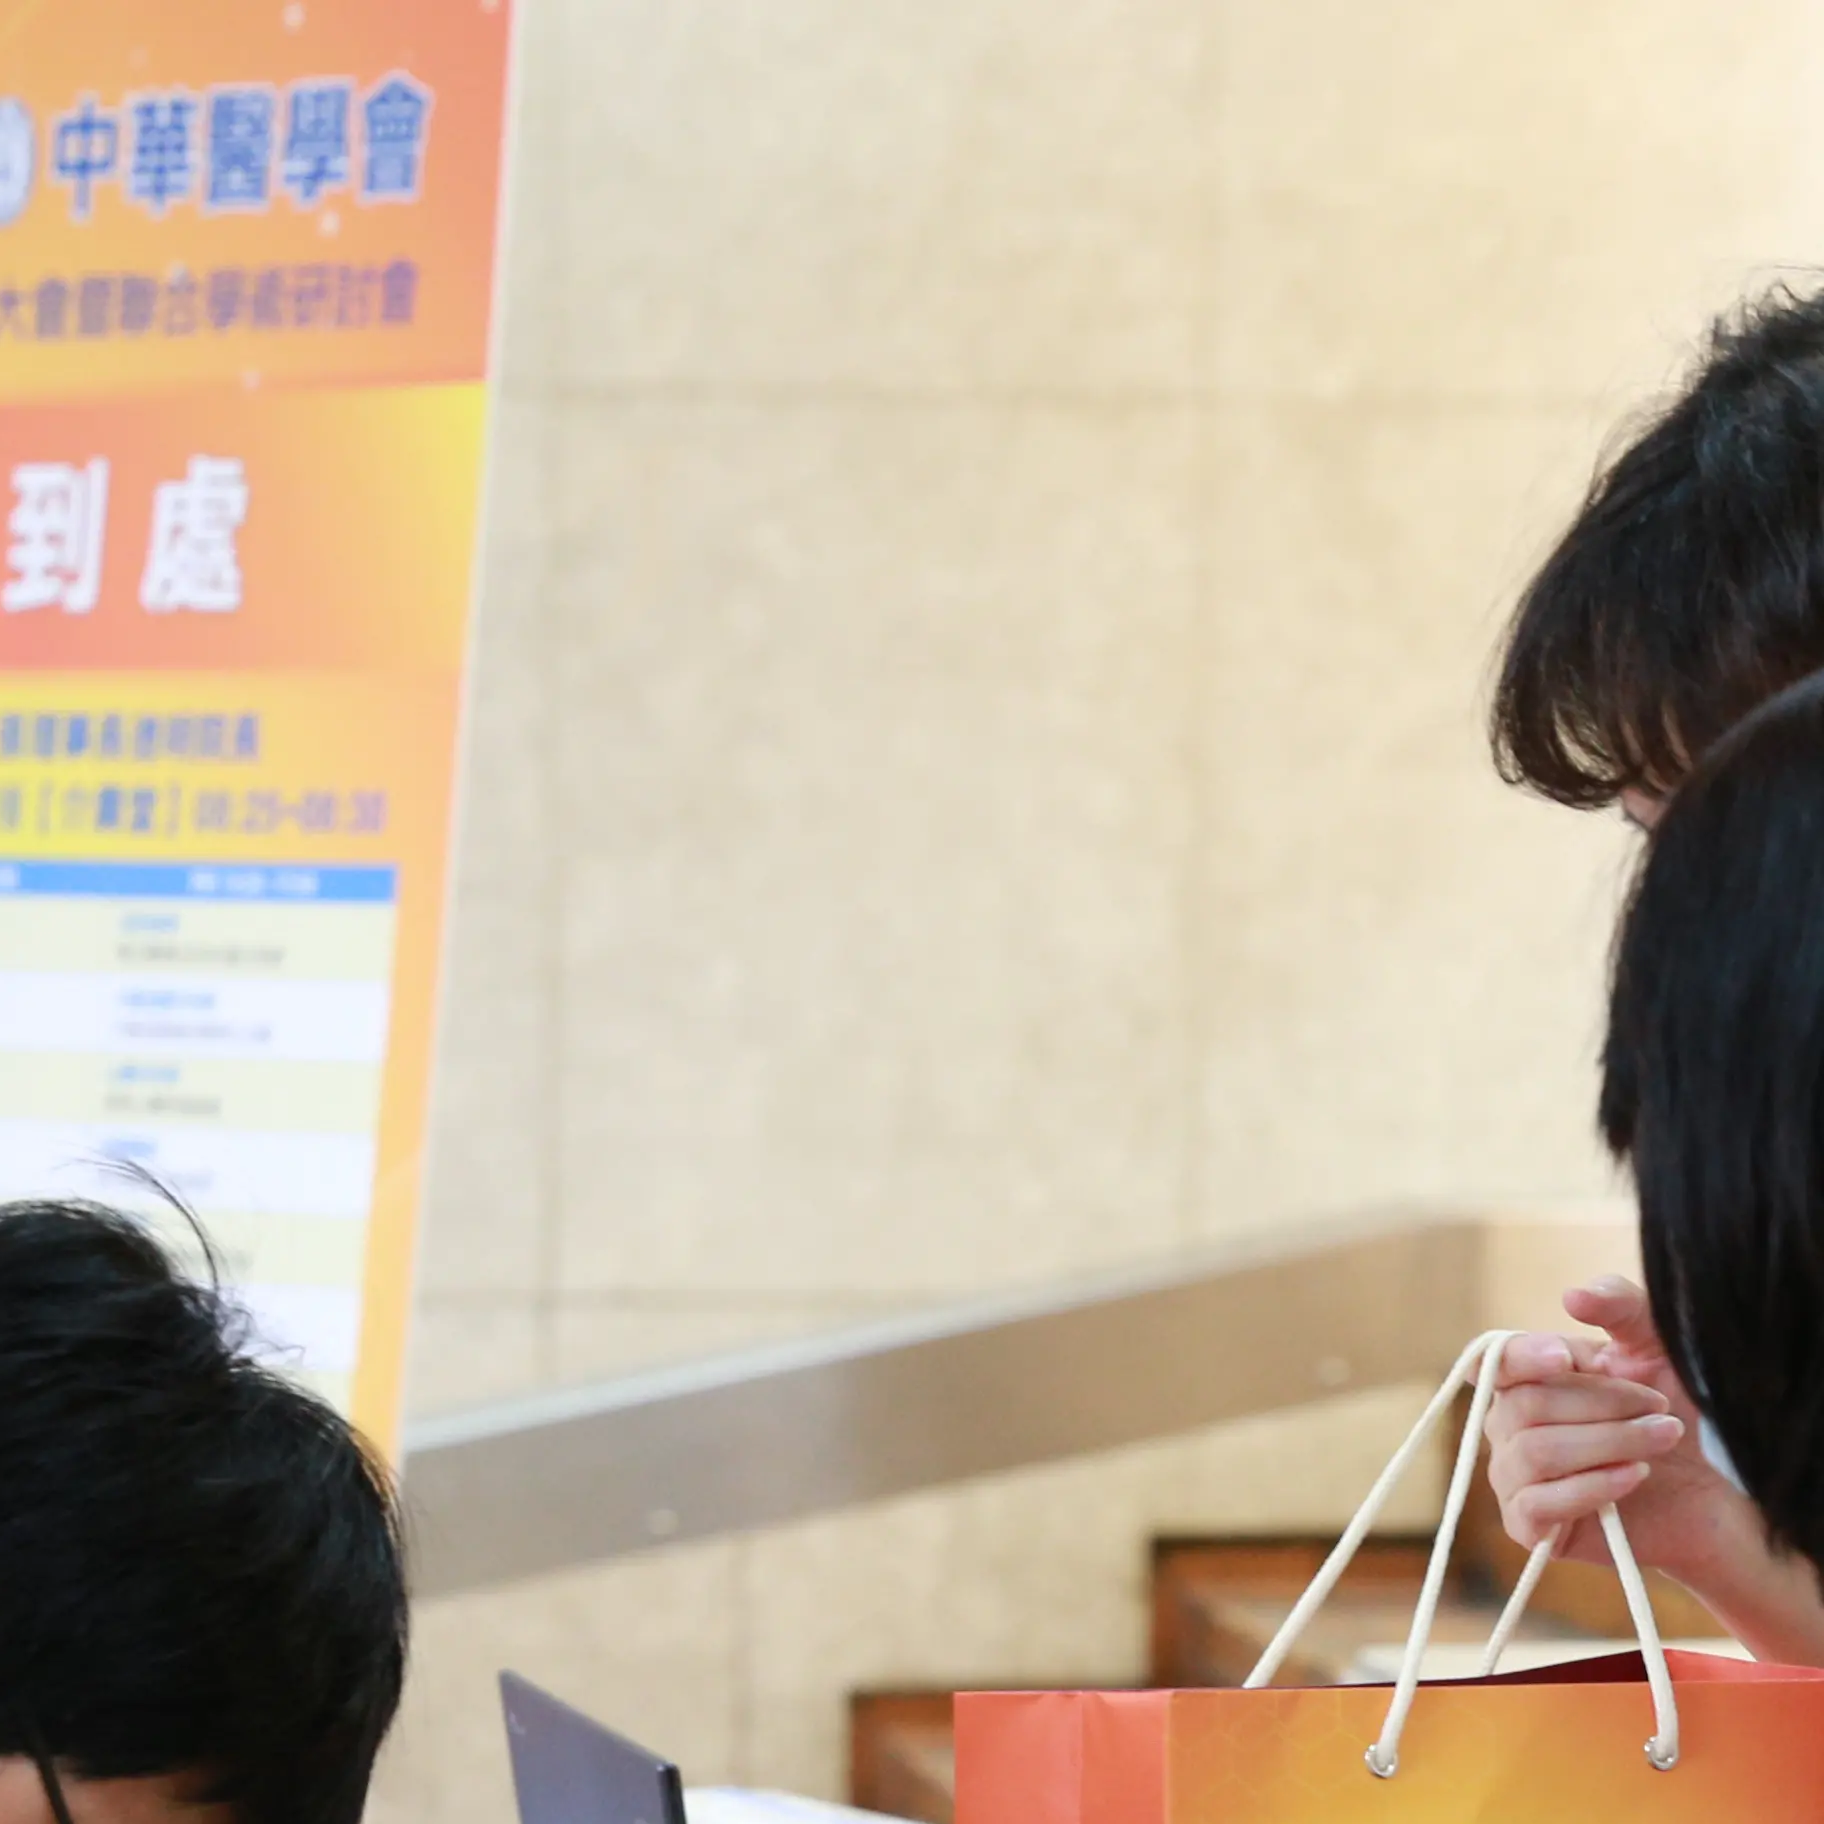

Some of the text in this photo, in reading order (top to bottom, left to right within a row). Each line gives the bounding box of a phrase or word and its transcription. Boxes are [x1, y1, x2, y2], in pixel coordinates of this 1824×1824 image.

[53, 76, 428, 220] 中華醫學會
